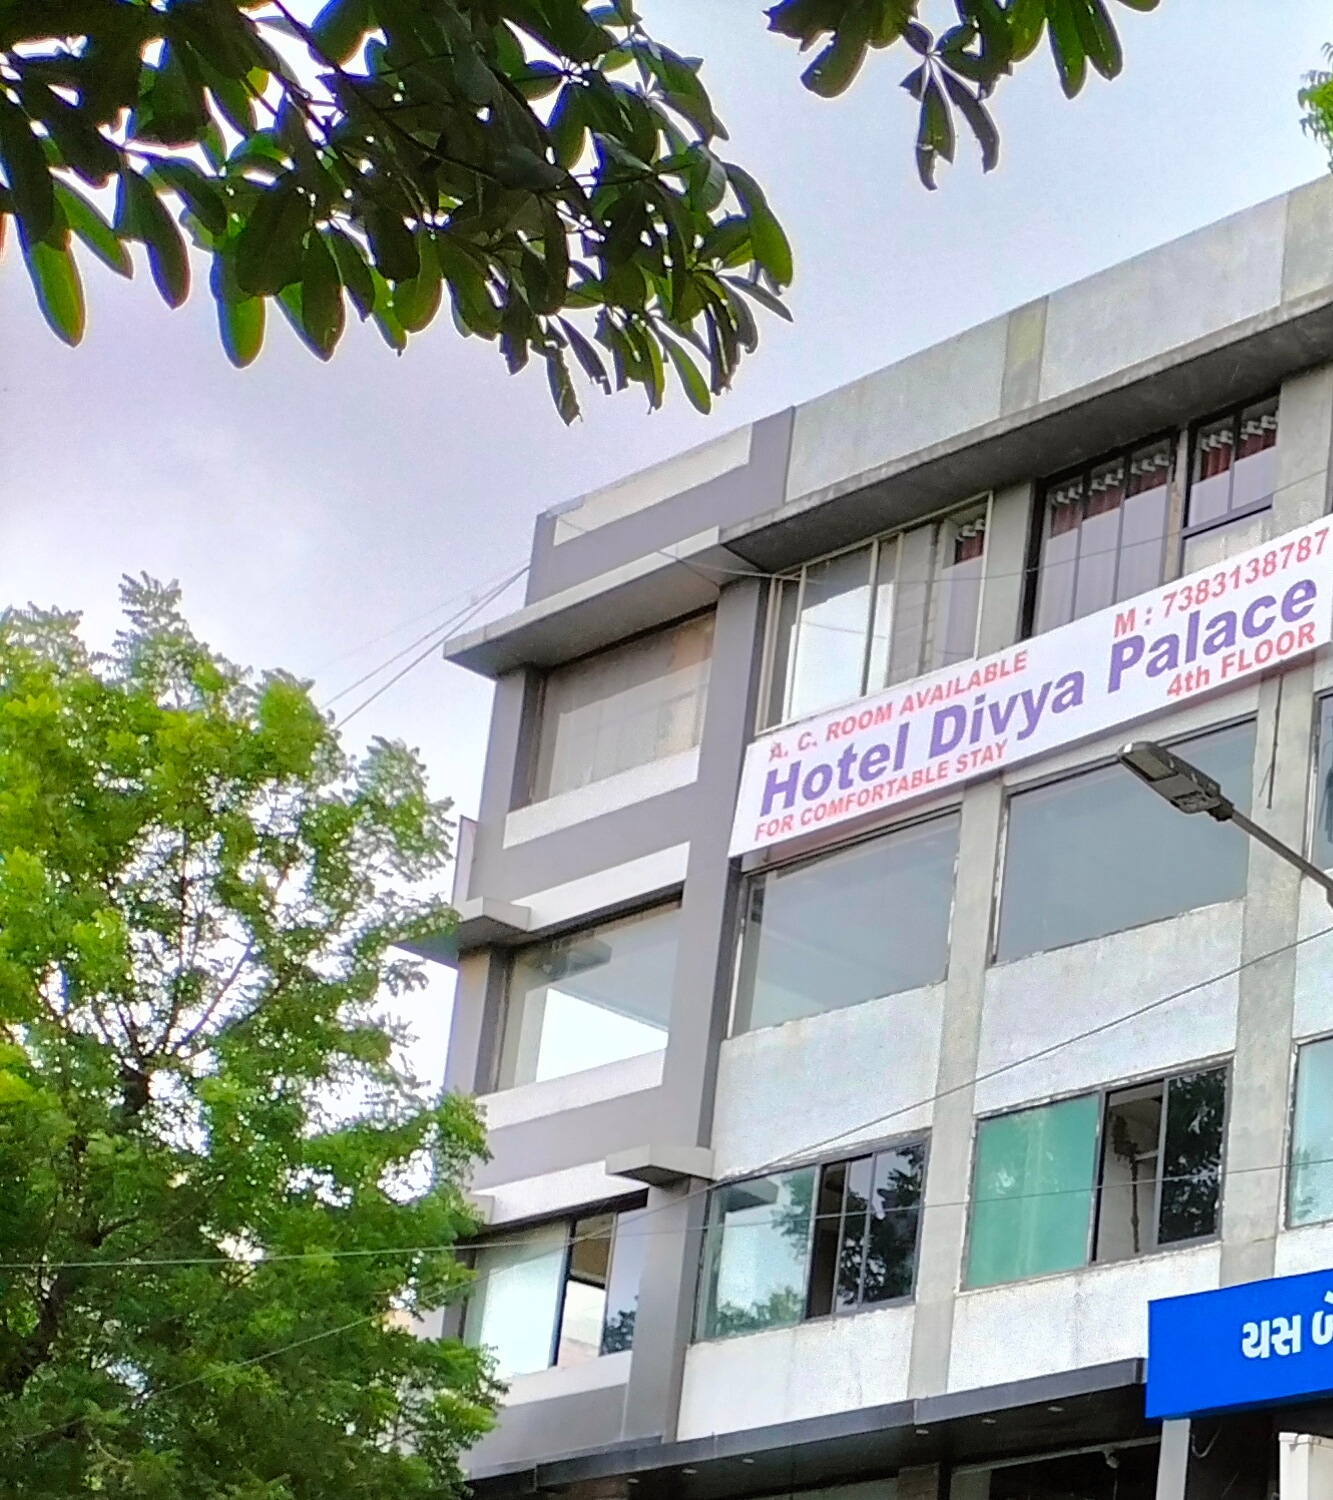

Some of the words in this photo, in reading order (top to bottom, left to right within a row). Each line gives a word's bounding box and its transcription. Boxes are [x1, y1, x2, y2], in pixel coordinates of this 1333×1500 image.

[1113, 611, 1136, 637] M
[1162, 526, 1331, 621] 7383138787
[758, 722, 908, 818] Hotel
[927, 668, 1084, 761] Divya
[1106, 577, 1319, 695] Palace
[768, 740, 787, 762] A.
[797, 732, 818, 756] C.
[825, 704, 893, 743] ROOM
[898, 649, 1029, 718] AVAILABLE
[1165, 666, 1212, 699] 4th
[1218, 622, 1318, 682] FLOOR
[753, 814, 795, 842] FOR
[798, 764, 952, 828] COMFORTABLE
[954, 738, 1009, 777] STAY
[1241, 1314, 1302, 1359] યસ
